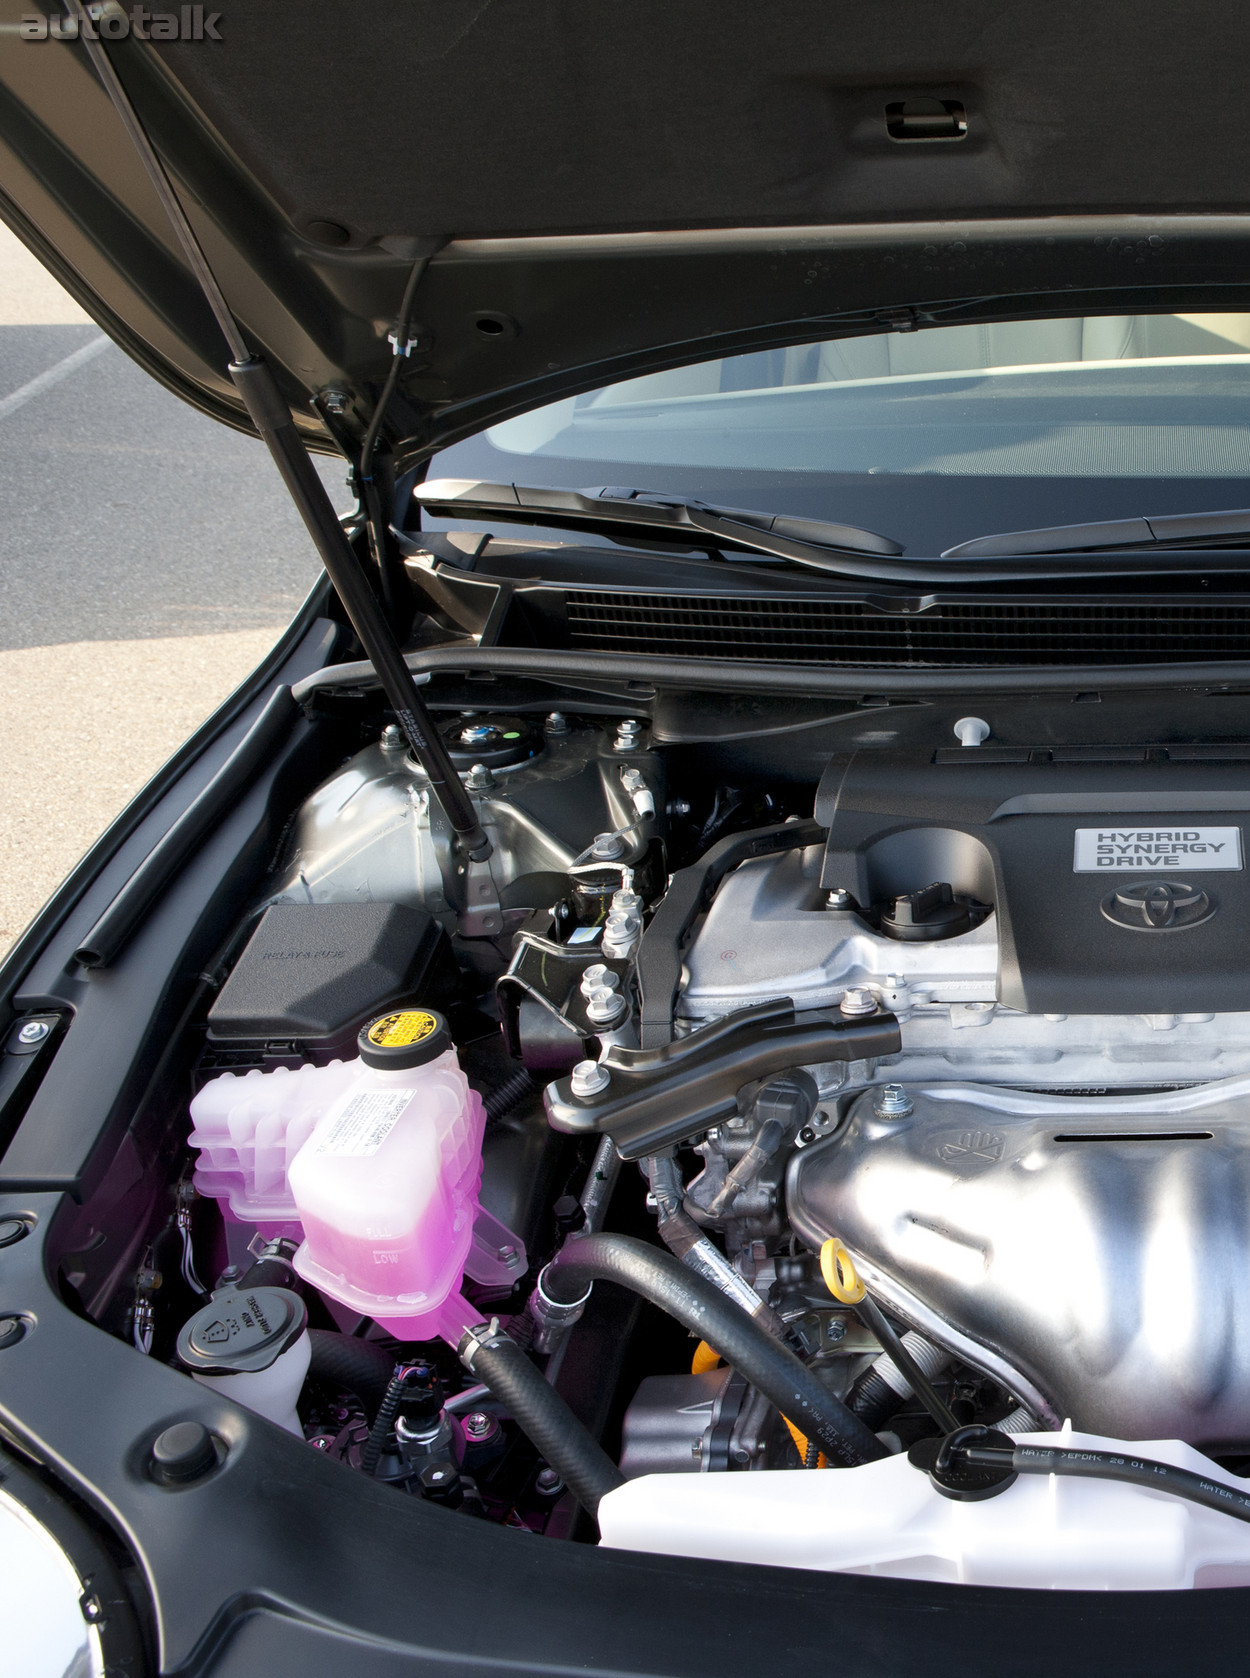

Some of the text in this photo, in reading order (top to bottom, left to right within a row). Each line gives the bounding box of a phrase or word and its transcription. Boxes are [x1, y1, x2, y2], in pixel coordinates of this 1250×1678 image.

[1098, 832, 1200, 842] HYBRID
[1097, 843, 1226, 854] SYNERGY
[1097, 856, 1180, 866] DRIVE
[373, 1254, 398, 1264] LOW
[1061, 1452, 1103, 1462] >EPDM<
[1109, 1457, 1125, 1465] 28
[1153, 1466, 1168, 1475] 12
[1200, 1481, 1233, 1500] WATER
